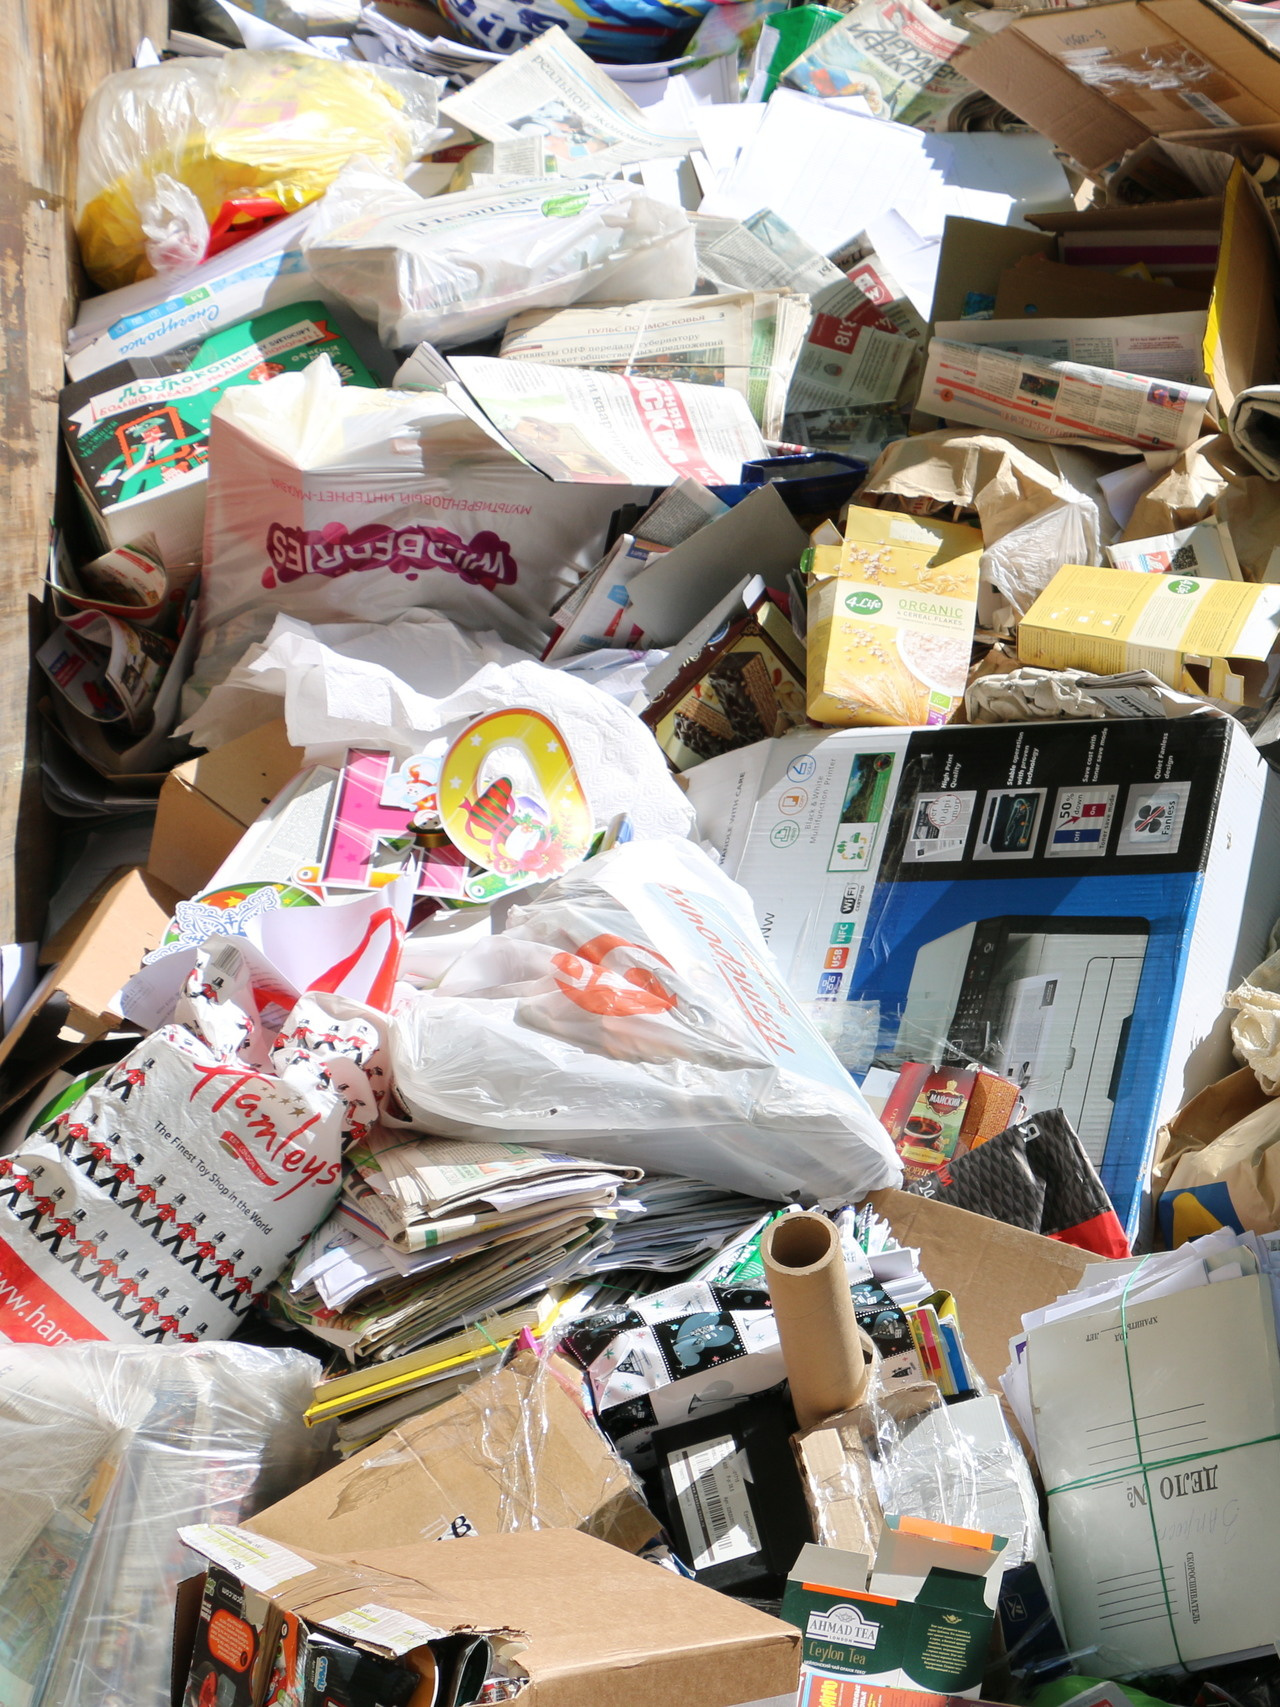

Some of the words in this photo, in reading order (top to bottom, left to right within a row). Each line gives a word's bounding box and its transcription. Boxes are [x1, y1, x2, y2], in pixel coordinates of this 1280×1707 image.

[859, 30, 936, 87] ФАКТЫ
[531, 54, 596, 112] реальной
[119, 304, 220, 354] Снегурочка
[587, 321, 622, 335] ПУЛЬС
[834, 319, 860, 348] 3.18
[561, 345, 587, 357] ОНФ
[398, 488, 533, 515] МУЛЬТИБРЕНДОВЫЙ
[899, 599, 964, 619] ORGANIC
[903, 611, 931, 621] CEREAL
[934, 615, 963, 626] FLAKES
[944, 753, 954, 772] Print
[1006, 764, 1017, 786] Stable
[1012, 731, 1024, 765] operation
[1016, 768, 1025, 786] with
[1021, 744, 1030, 769] proven
[1025, 747, 1040, 785] technology
[1082, 765, 1091, 783] Save
[1090, 734, 1098, 749] with
[1092, 762, 1100, 782] toner
[1100, 727, 1109, 746] mode
[1154, 758, 1164, 779] Quiet
[1159, 732, 1169, 759] Fanless
[1164, 755, 1173, 779] design
[941, 770, 949, 788] High
[949, 762, 962, 789] Quality
[805, 809, 815, 830] Black
[814, 775, 824, 798] White
[809, 789, 829, 844] Multifunction
[824, 758, 837, 786] Printer
[1074, 794, 1084, 816] down
[1090, 806, 1097, 816] On
[719, 827, 733, 865] HANDLE
[729, 801, 739, 825] WITH
[735, 771, 746, 797] CARE
[1099, 830, 1108, 850] Toner
[1108, 793, 1116, 814] mode
[1161, 801, 1176, 836] Fanless
[855, 885, 865, 912] CERTIFIED
[836, 924, 849, 942] NFC
[830, 949, 843, 967] USB
[928, 1093, 961, 1108] МАЙСКИЙ
[189, 1063, 342, 1202] Hamleys
[239, 1145, 255, 1169] LONDON
[153, 1119, 173, 1141] The
[171, 1136, 196, 1164] Finest
[196, 1158, 210, 1178] Toy
[208, 1173, 230, 1196] Shop
[226, 1192, 237, 1204] in
[236, 1198, 251, 1217] the
[249, 1211, 274, 1236] World
[1127, 1315, 1159, 1331] ХРАНИТЬ
[1085, 1331, 1101, 1343] ЛЕТ
[1159, 1463, 1219, 1501] ДЕЛО
[1186, 1551, 1201, 1625] СКОРОСШИВАТЕЛЬ
[809, 1619, 853, 1636] AHMAD
[854, 1627, 876, 1642] TEA
[828, 1635, 854, 1644] LONDON
[808, 1641, 845, 1664] Ceylon
[849, 1648, 867, 1666] Tea
